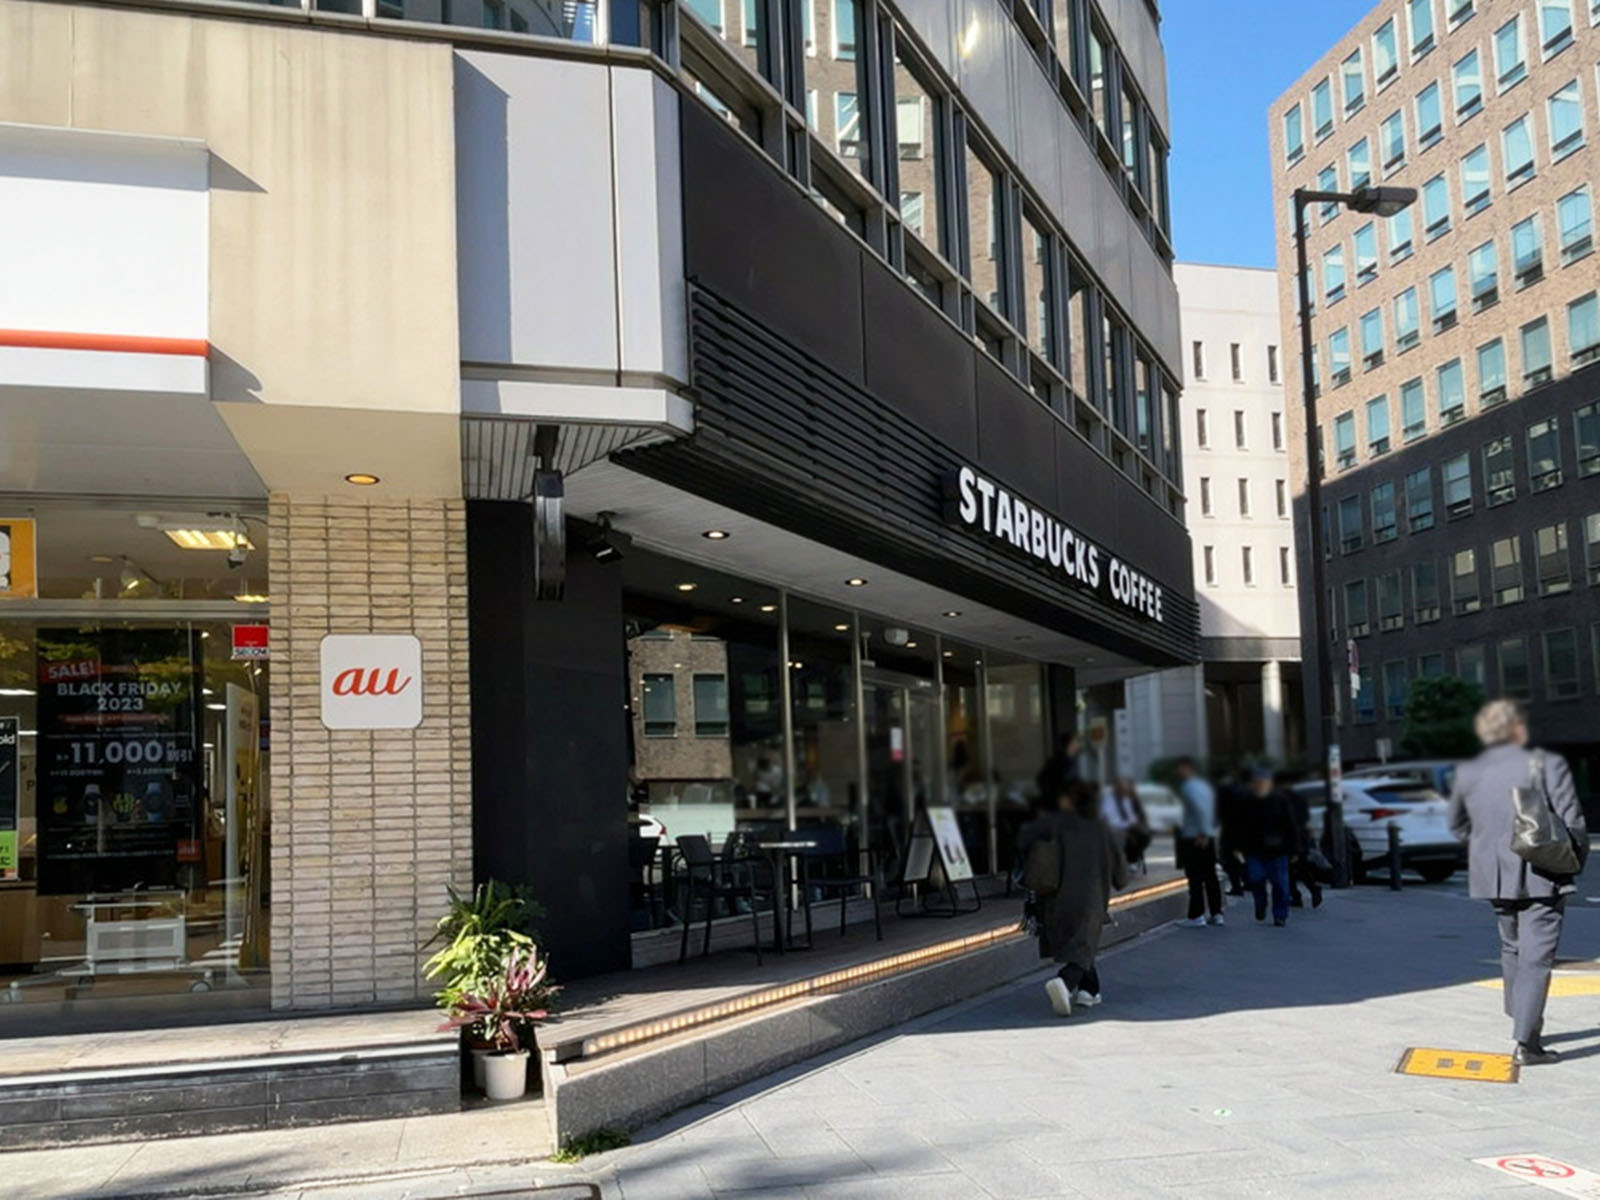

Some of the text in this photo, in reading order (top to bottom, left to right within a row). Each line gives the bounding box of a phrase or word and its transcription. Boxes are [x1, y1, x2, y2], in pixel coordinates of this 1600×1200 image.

[959, 466, 1163, 622] STARBUCKS COFFEE
[48, 660, 95, 679] SALE!
[57, 682, 182, 696] BLACK FRIDAY
[332, 667, 412, 696] au
[97, 697, 144, 711] 2023
